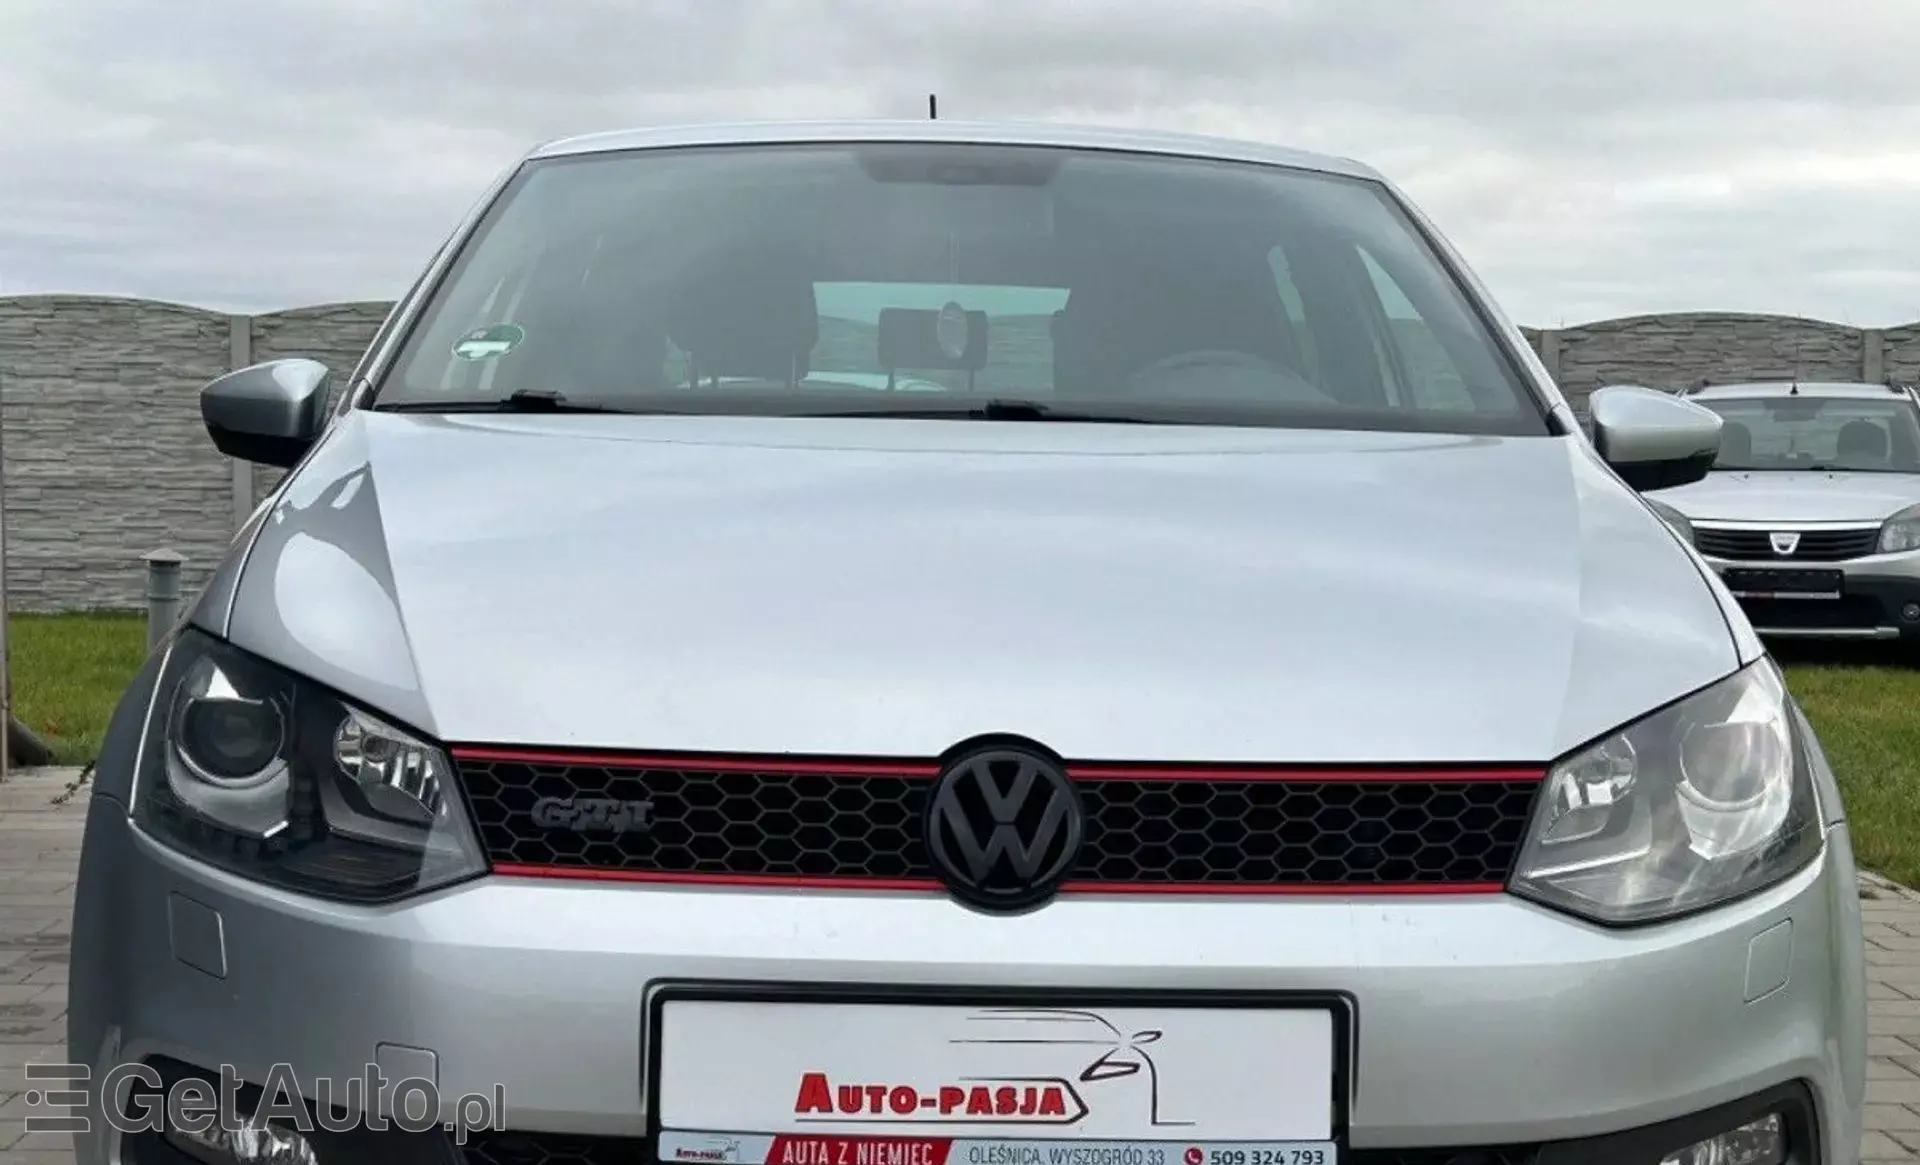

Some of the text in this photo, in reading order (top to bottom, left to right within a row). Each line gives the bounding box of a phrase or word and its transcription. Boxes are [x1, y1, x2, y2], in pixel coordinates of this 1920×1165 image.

[931, 751, 1081, 895] VW
[783, 1141, 933, 1165] AUTA Z NIEMIEC
[1050, 1146, 1143, 1165] WYSZOGRÓD
[1149, 1149, 1165, 1165] 33
[1210, 1150, 1324, 1165] 509 324 793
